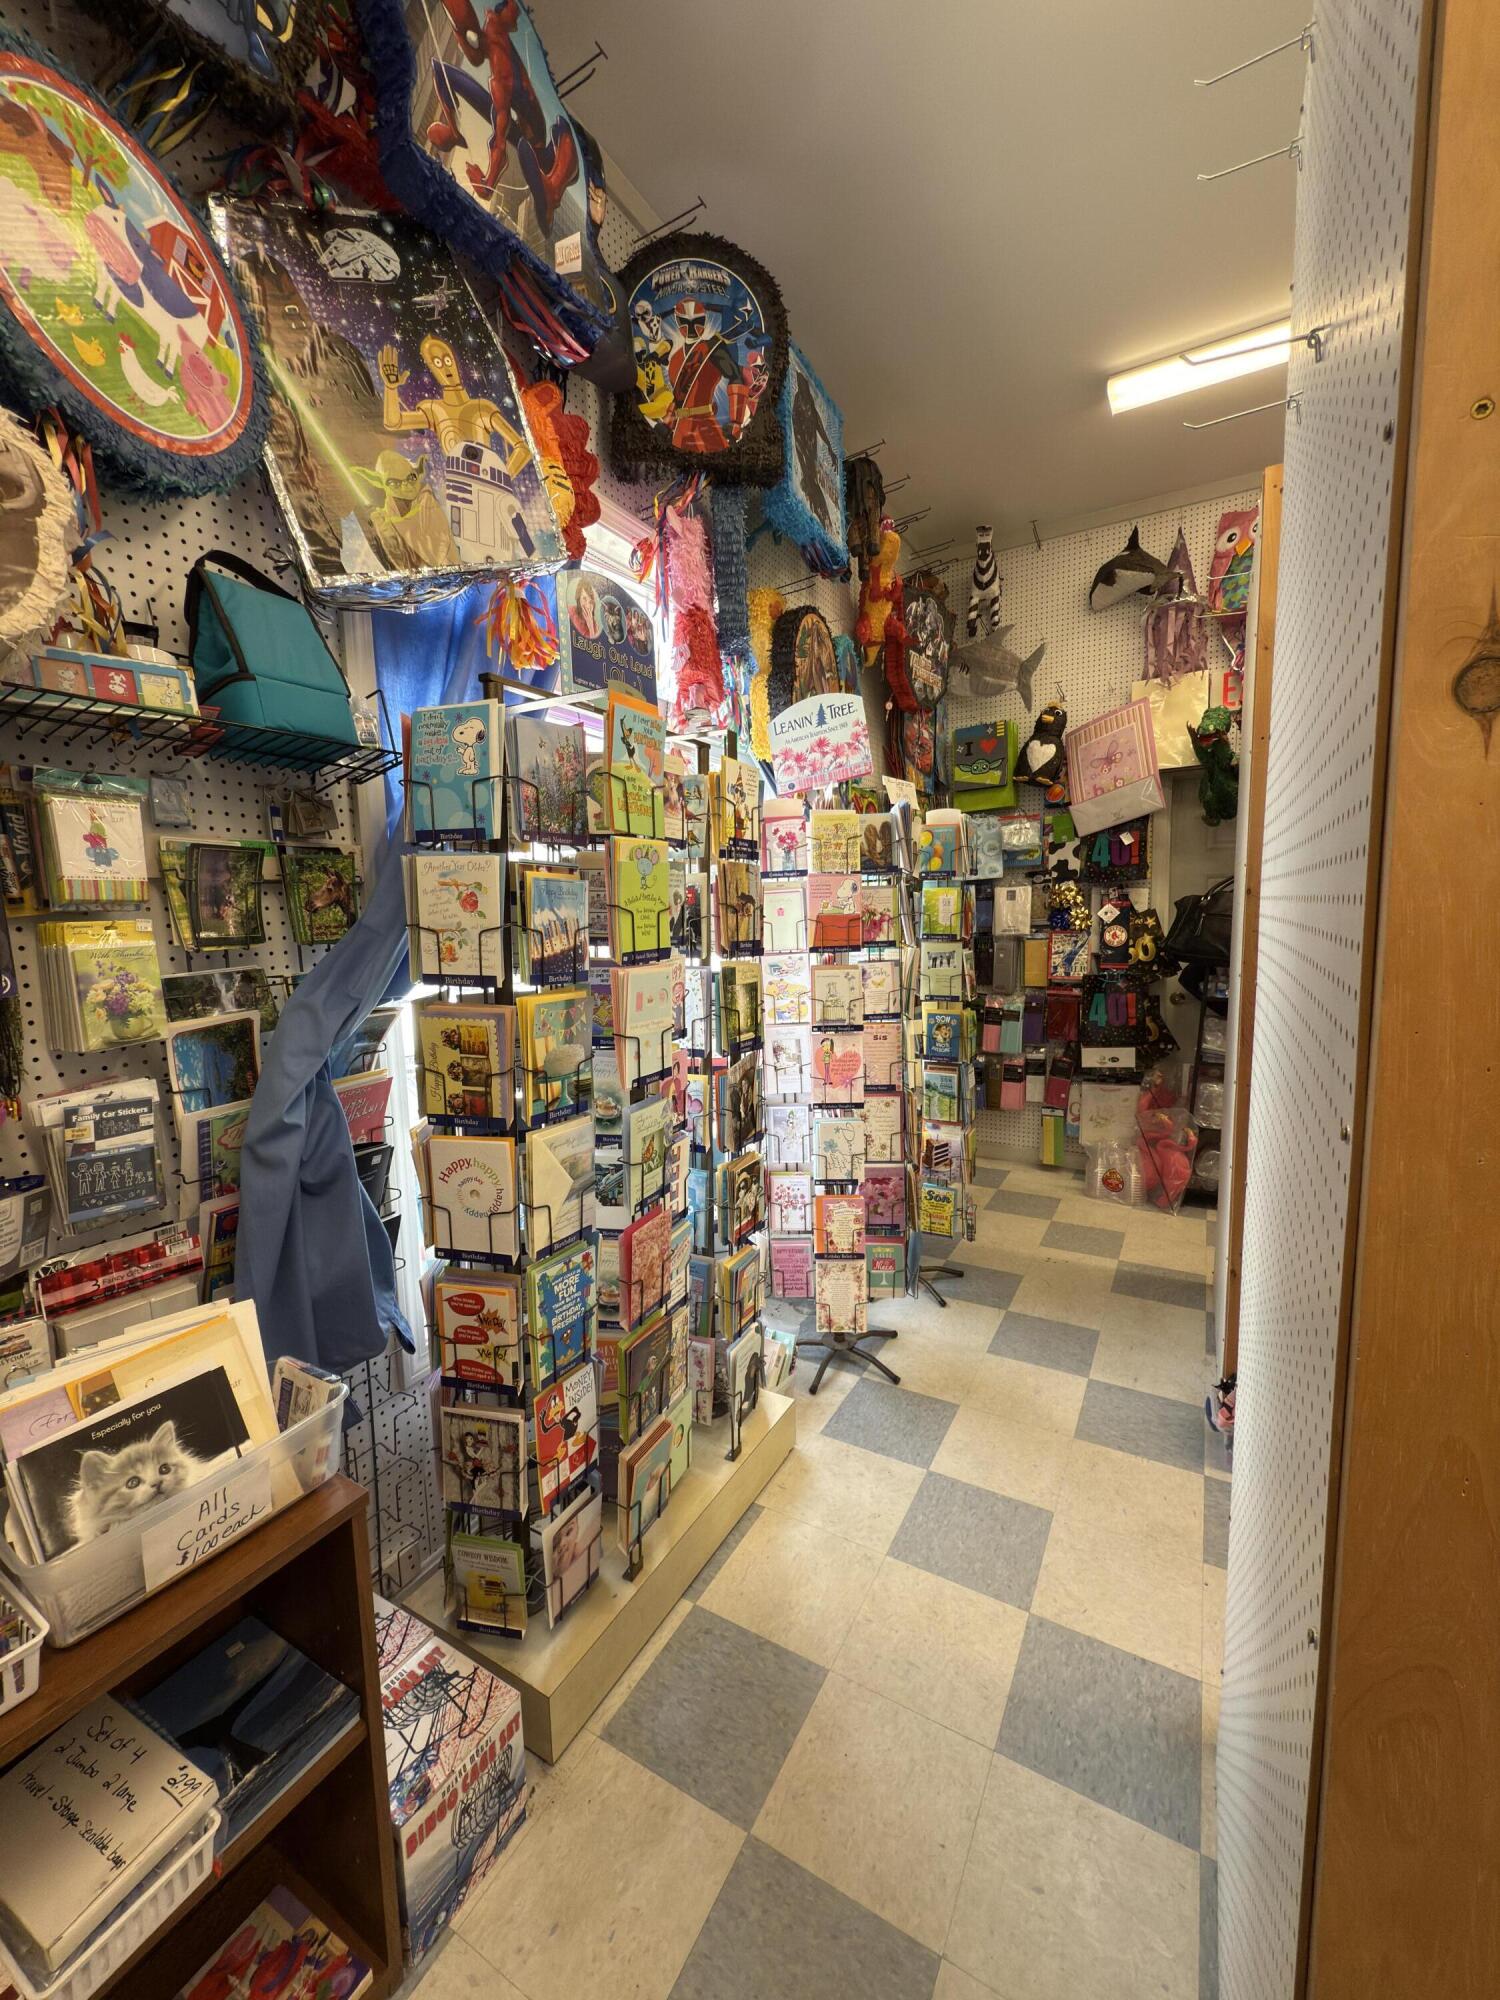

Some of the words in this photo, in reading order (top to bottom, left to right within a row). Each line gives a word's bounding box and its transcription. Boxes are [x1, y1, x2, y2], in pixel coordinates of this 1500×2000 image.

[572, 630, 606, 660] Laugh
[609, 647, 629, 668] Out
[630, 655, 655, 679] Loud
[773, 711, 813, 736] LEANIN'
[827, 702, 856, 720] TREE
[6, 812, 31, 855] Vivid
[445, 976, 475, 985] Birthday
[548, 973, 574, 983] Birthday
[1089, 992, 1137, 1027] 40!
[72, 1112, 100, 1123] Family
[102, 1110, 117, 1119] Car
[117, 1106, 148, 1116] Stickers
[454, 1117, 480, 1127] Birthday
[548, 1107, 573, 1119] Birthday
[102, 1273, 125, 1286] Fancy
[554, 1273, 580, 1295] MORE
[559, 1284, 577, 1301] FUN
[551, 1302, 583, 1326] BIRTHDAY
[552, 1307, 585, 1334] PRESENT?
[565, 1367, 593, 1397] MONEY
[568, 1383, 594, 1407] INSIDE!
[91, 1416, 132, 1440] Especially
[131, 1409, 146, 1423] for
[146, 1403, 162, 1417] you
[198, 1487, 227, 1522] All
[471, 1506, 501, 1516] Birthday
[177, 1502, 240, 1551] Cards
[222, 1504, 266, 1539] each
[382, 1670, 423, 1709] CAGE
[418, 1646, 447, 1674] SET
[87, 1715, 117, 1744] Set
[130, 1745, 147, 1765] 4
[469, 1735, 492, 1766] METAL
[66, 1746, 100, 1778] Jumbo
[102, 1773, 121, 1791] 2
[111, 1780, 138, 1813] large
[406, 1787, 459, 1859] BINGO
[461, 1740, 497, 1793] CAGE
[498, 1711, 521, 1750] SET
